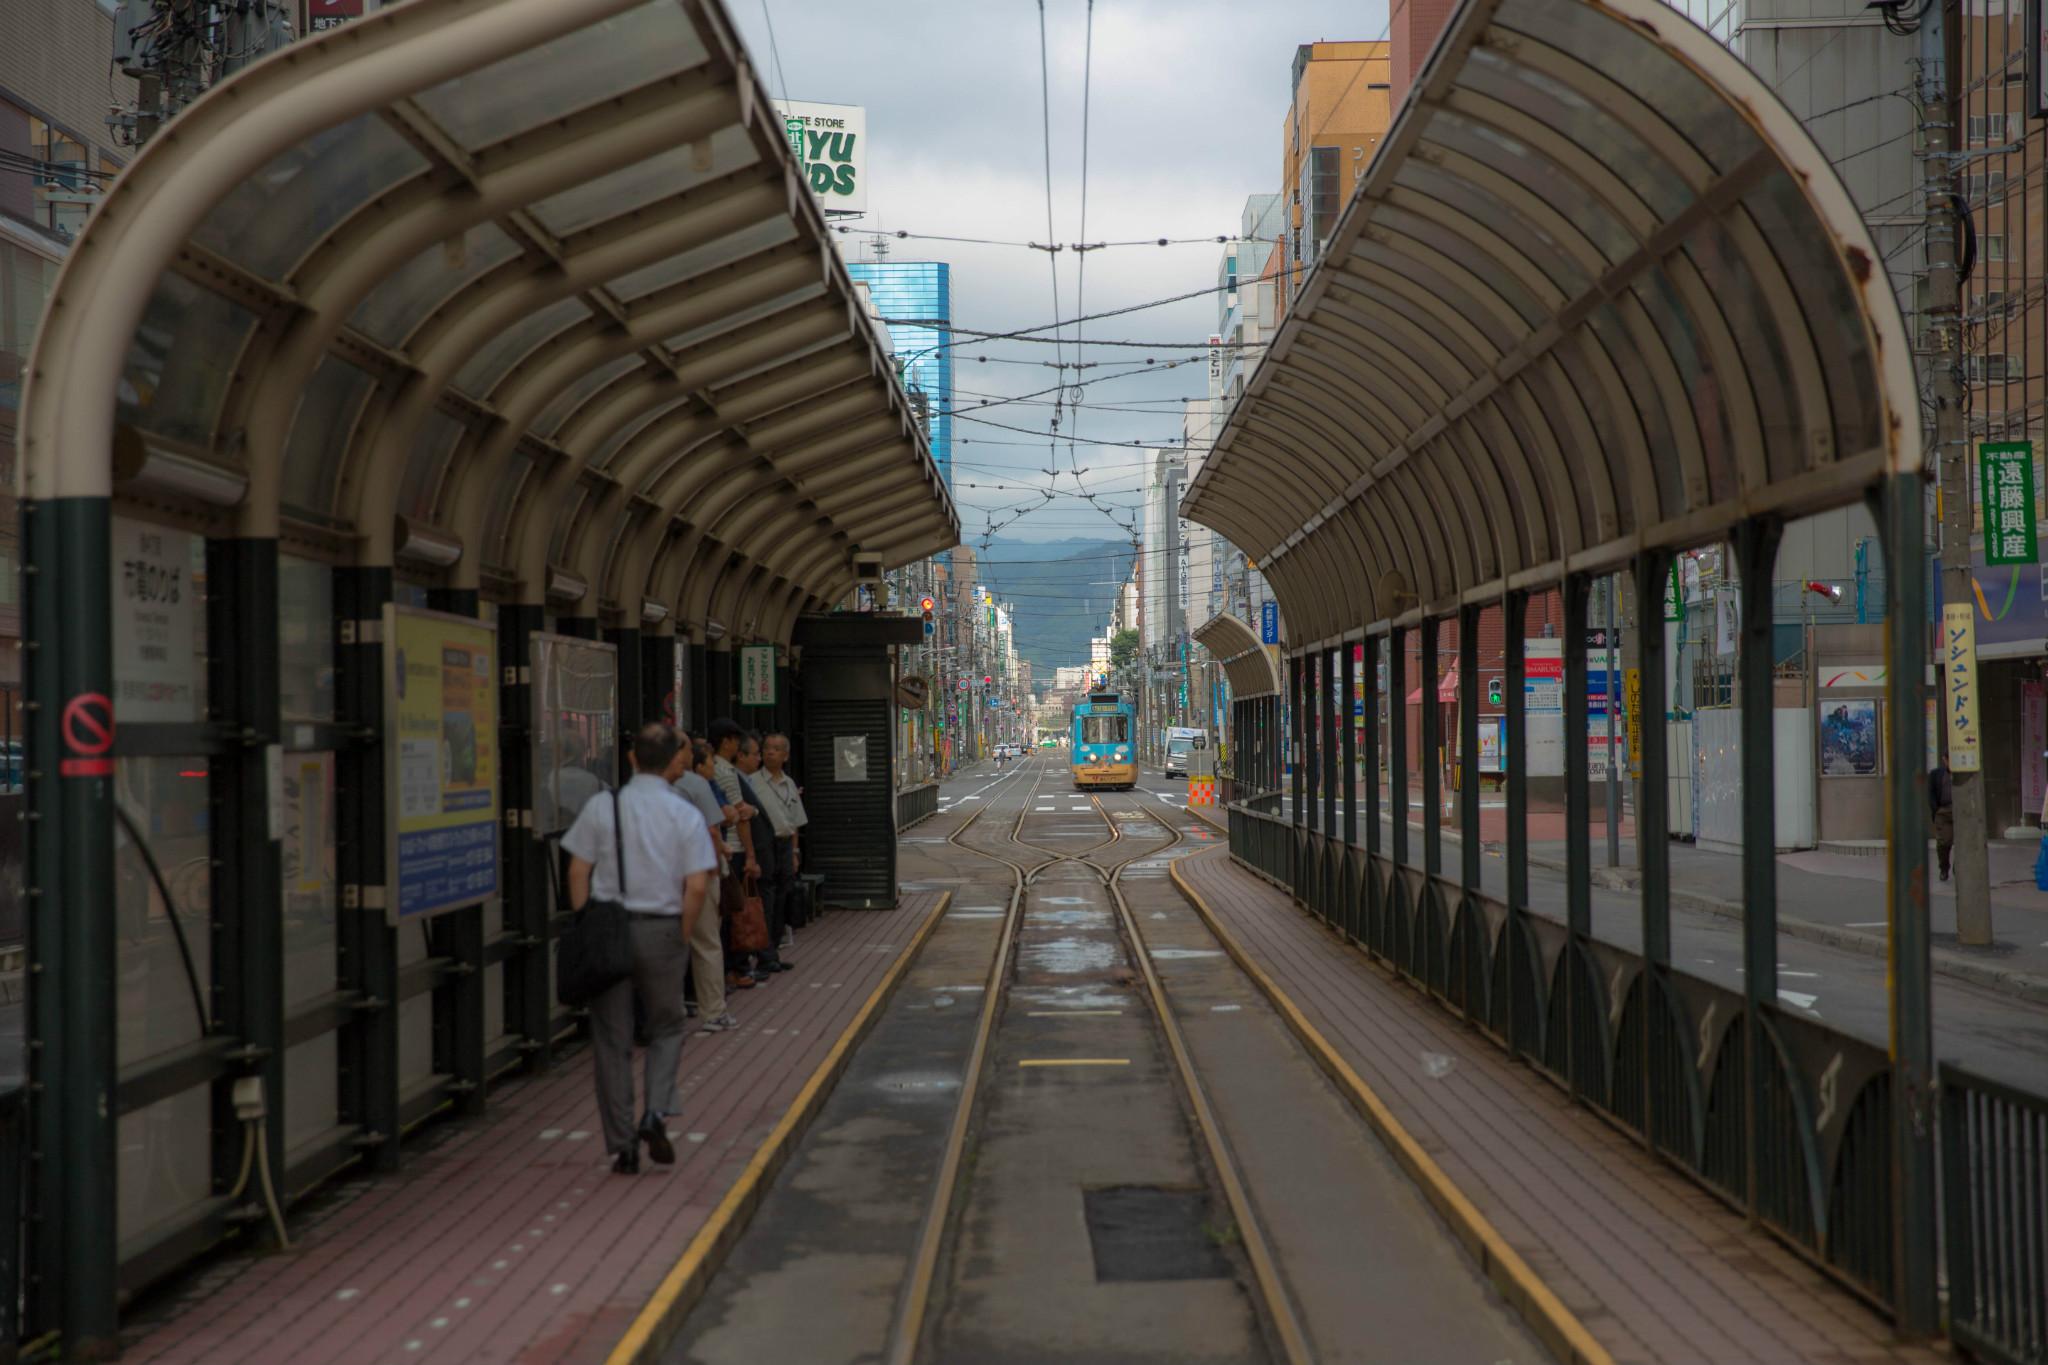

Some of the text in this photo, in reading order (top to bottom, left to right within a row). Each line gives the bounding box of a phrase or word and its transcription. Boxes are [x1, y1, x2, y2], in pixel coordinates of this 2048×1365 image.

[814, 117, 845, 128] STORE
[804, 130, 856, 163] YU
[1985, 451, 2026, 461] 不動産
[1998, 460, 2027, 558] 遠藤興産
